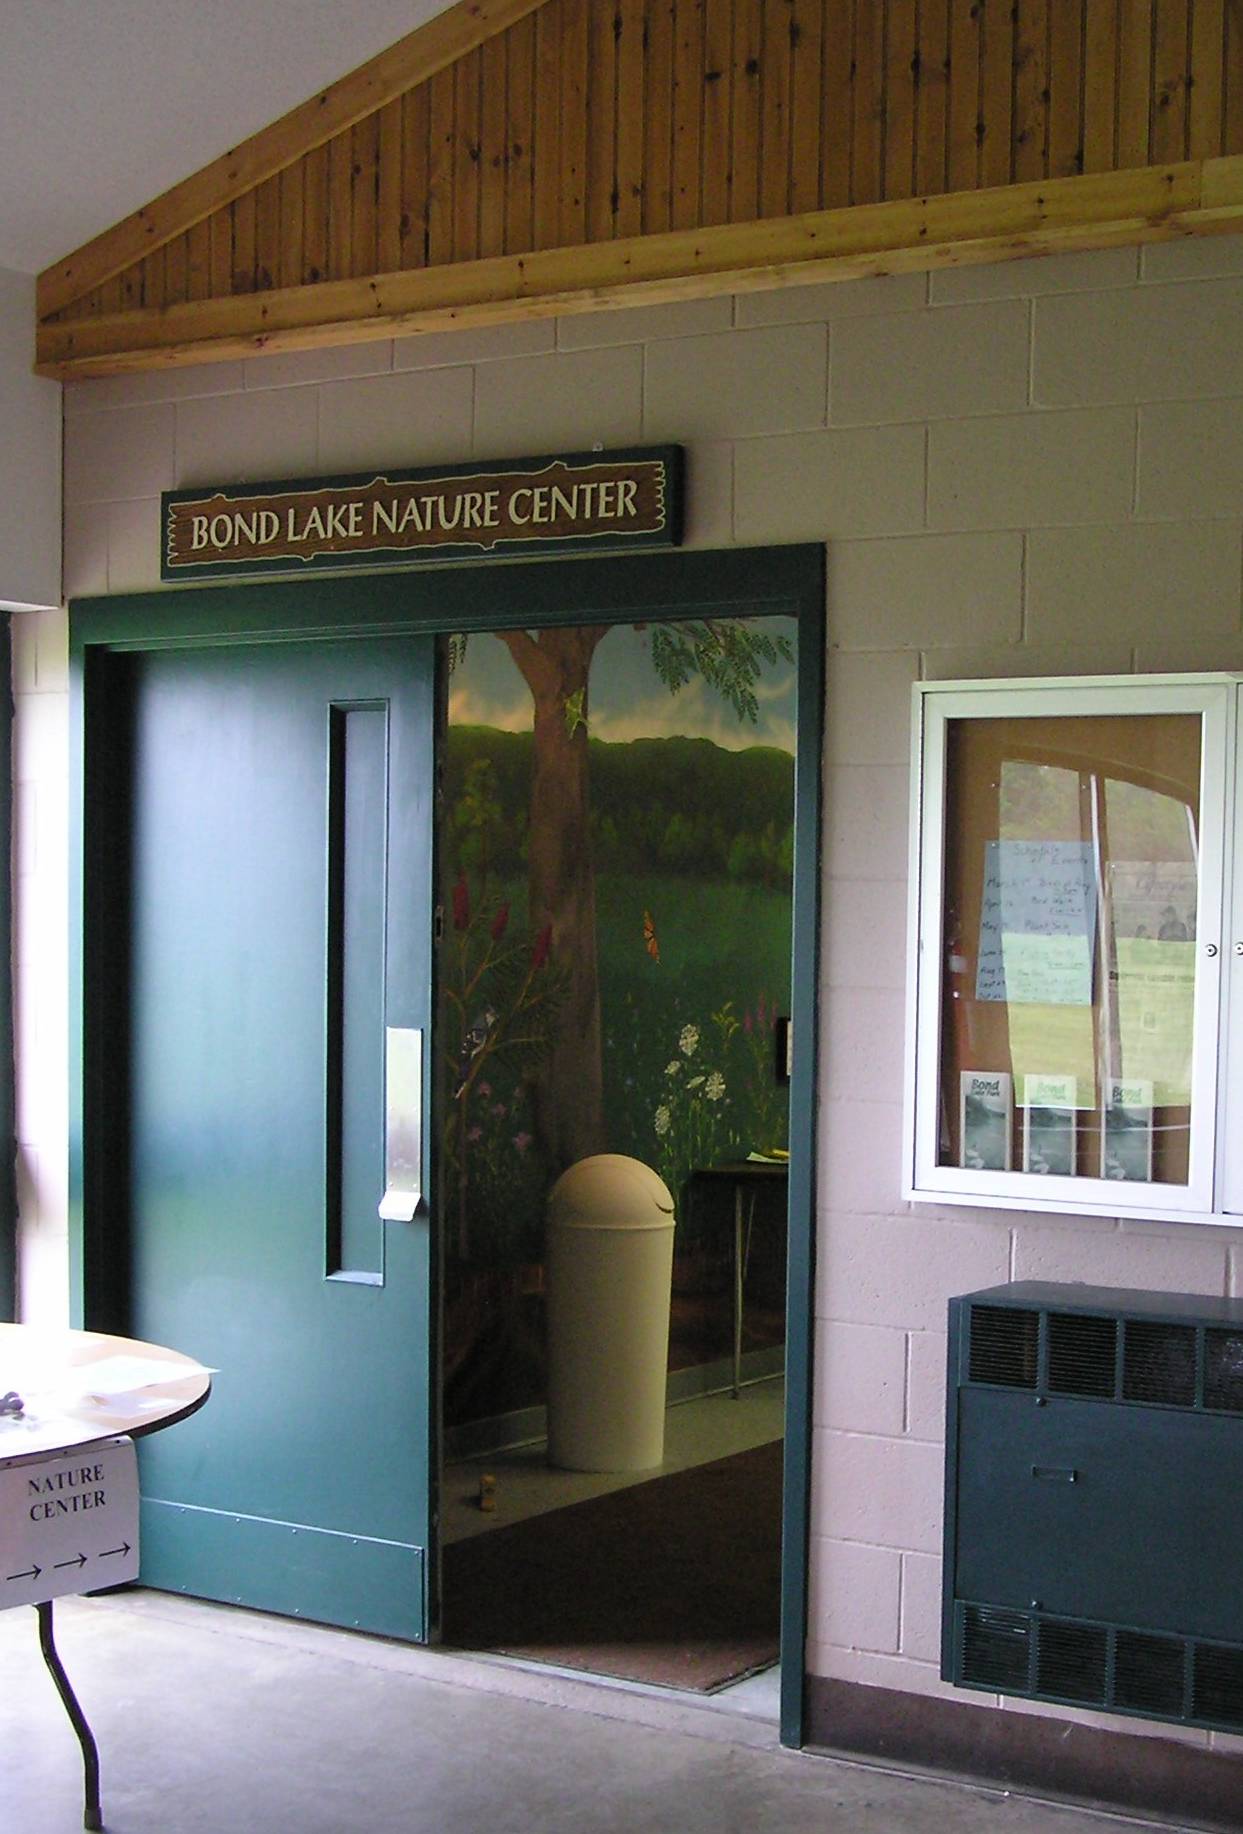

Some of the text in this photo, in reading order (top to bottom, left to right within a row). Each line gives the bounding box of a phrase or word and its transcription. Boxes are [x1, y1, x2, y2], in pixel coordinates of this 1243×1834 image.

[190, 479, 638, 551] BOND LAKE NATURE CENTER
[28, 1464, 105, 1496] NATURE
[29, 1490, 106, 1522] CENTER
